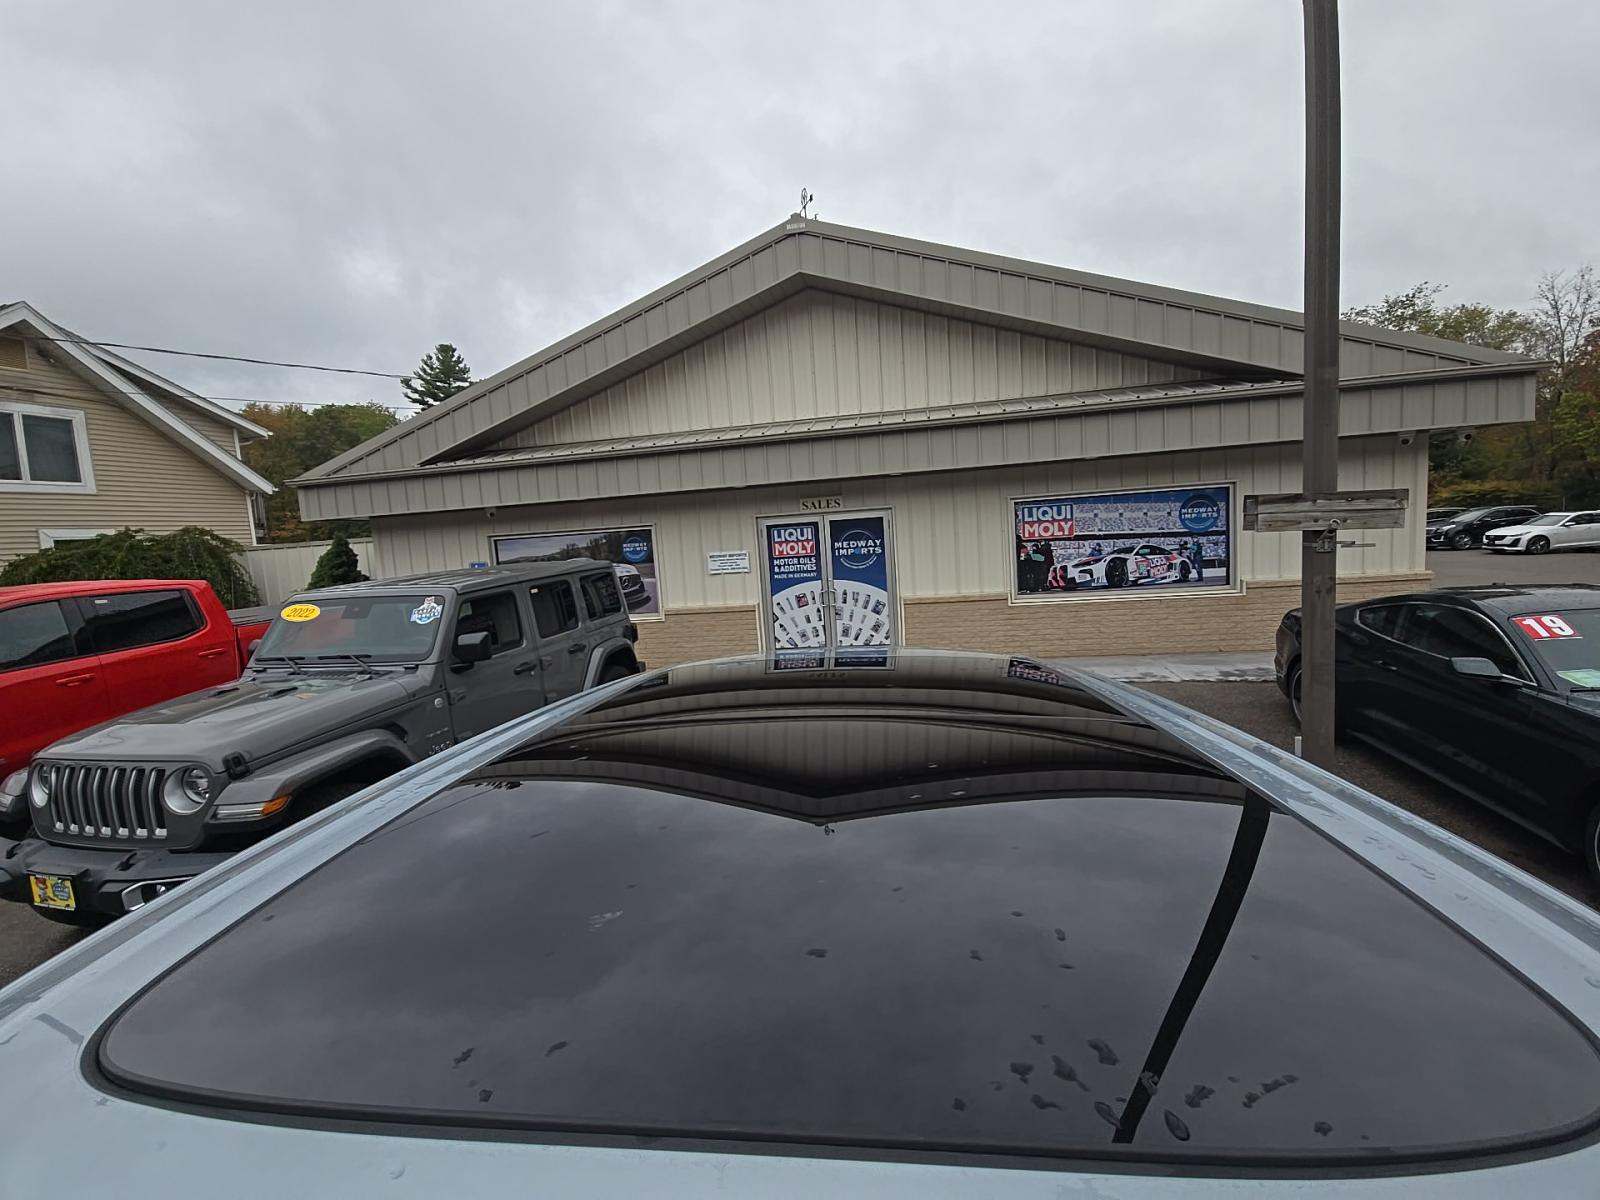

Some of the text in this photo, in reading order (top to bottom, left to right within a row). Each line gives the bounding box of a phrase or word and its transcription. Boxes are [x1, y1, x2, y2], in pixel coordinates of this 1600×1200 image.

[801, 498, 841, 511] SALES
[1181, 506, 1218, 514] MEDWAY
[1023, 505, 1072, 522] LIQUI
[773, 527, 812, 542] LIQUI
[1024, 521, 1073, 538] MOLY
[774, 541, 814, 556] MOLY
[834, 538, 882, 549] MEDWAY
[835, 546, 882, 556] IMPORTS
[773, 556, 816, 566] MOTOR OILS
[780, 564, 816, 572] ADDITIVES
[286, 607, 315, 618] 2022
[1522, 615, 1575, 638] 19
